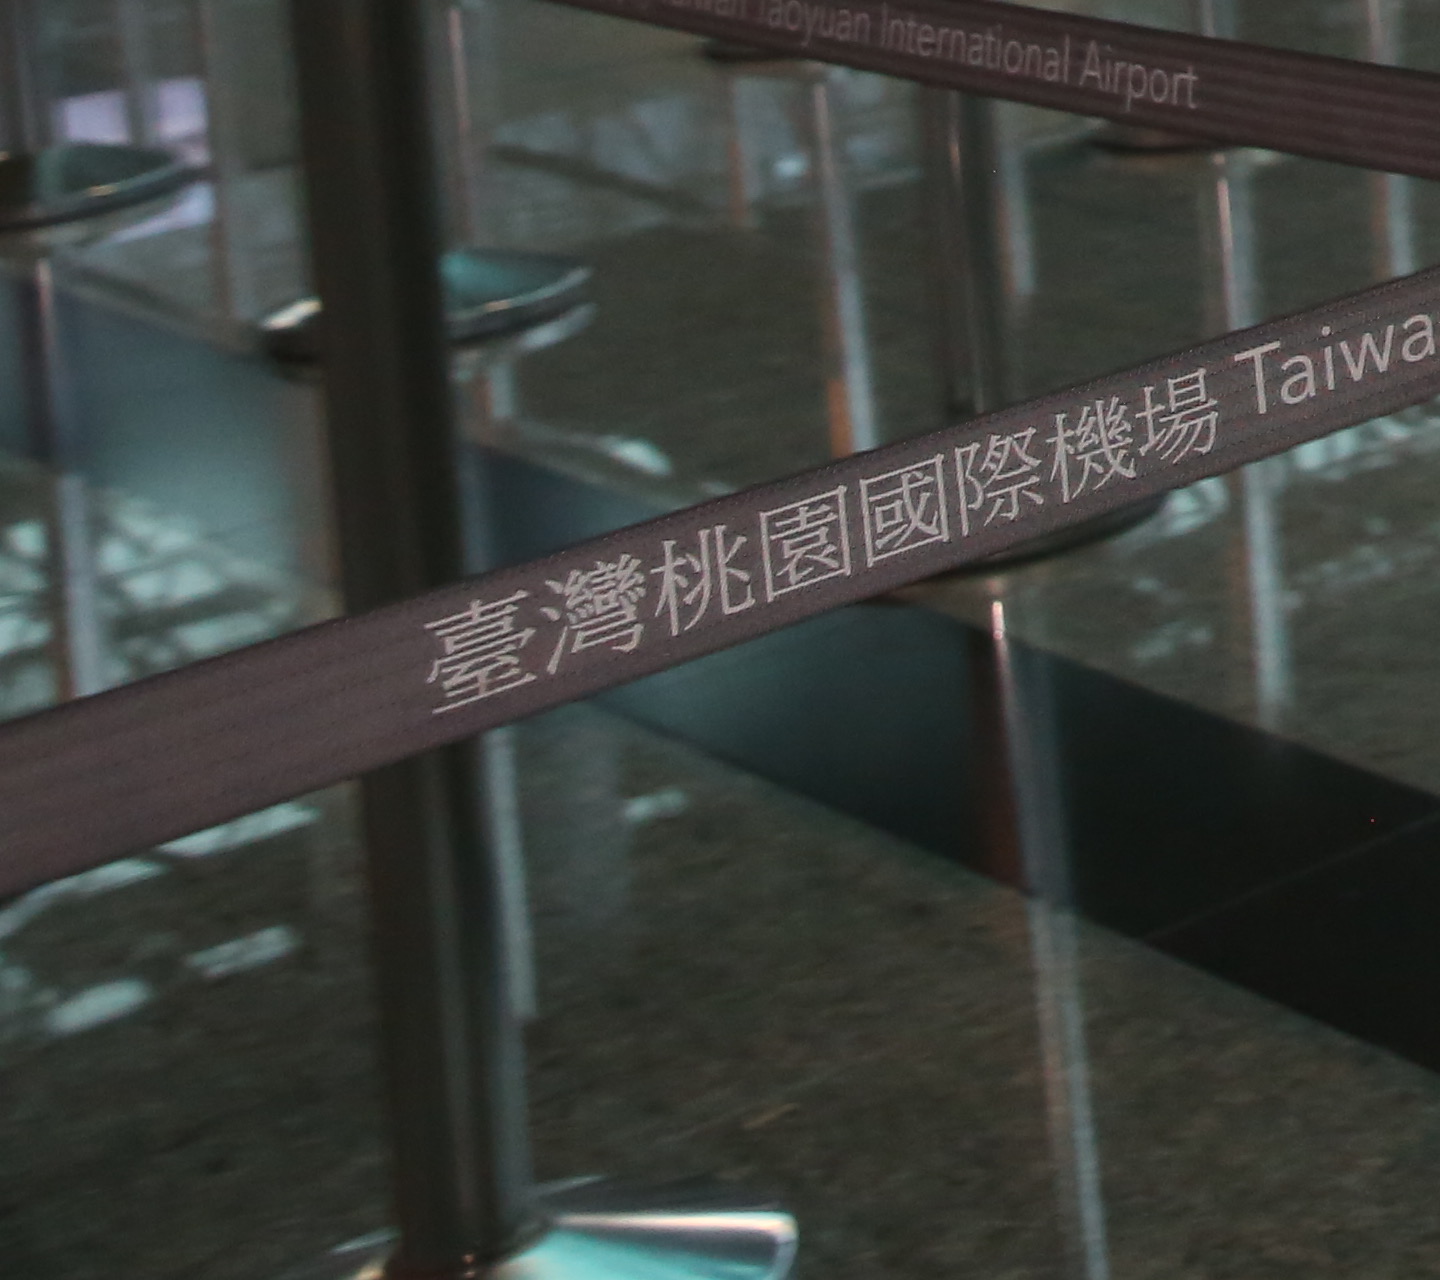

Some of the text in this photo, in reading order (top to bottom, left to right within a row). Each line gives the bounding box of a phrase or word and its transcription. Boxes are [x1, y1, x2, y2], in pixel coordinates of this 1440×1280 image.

[879, 2, 1071, 86] International
[1078, 39, 1199, 113] Airport
[423, 370, 1219, 716] 臺灣桃園國際機場
